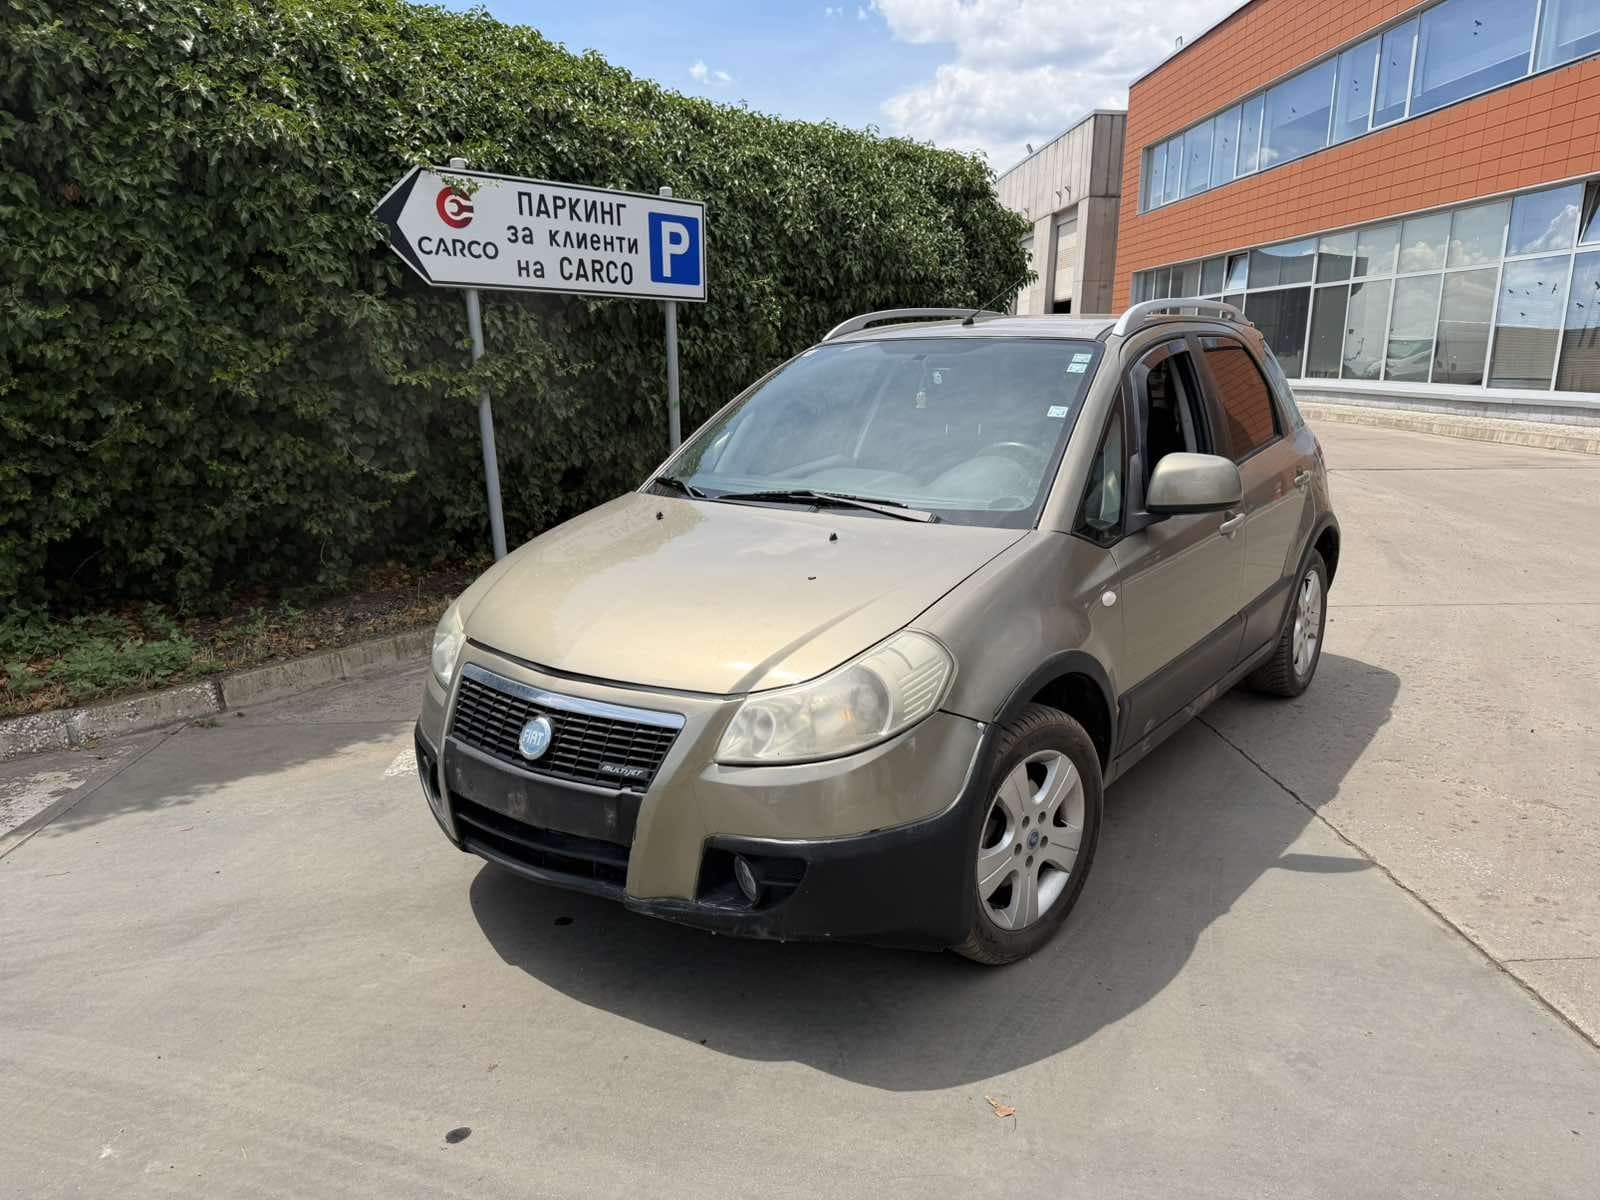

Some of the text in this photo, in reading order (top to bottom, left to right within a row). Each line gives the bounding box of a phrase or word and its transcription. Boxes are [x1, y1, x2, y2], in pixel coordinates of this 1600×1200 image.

[517, 191, 627, 227] ПАРКИНГ
[417, 236, 499, 260] CARCO
[506, 226, 639, 255] за клиенти
[661, 221, 690, 277] P
[517, 256, 634, 286] на CARCO
[523, 728, 545, 746] FIAT
